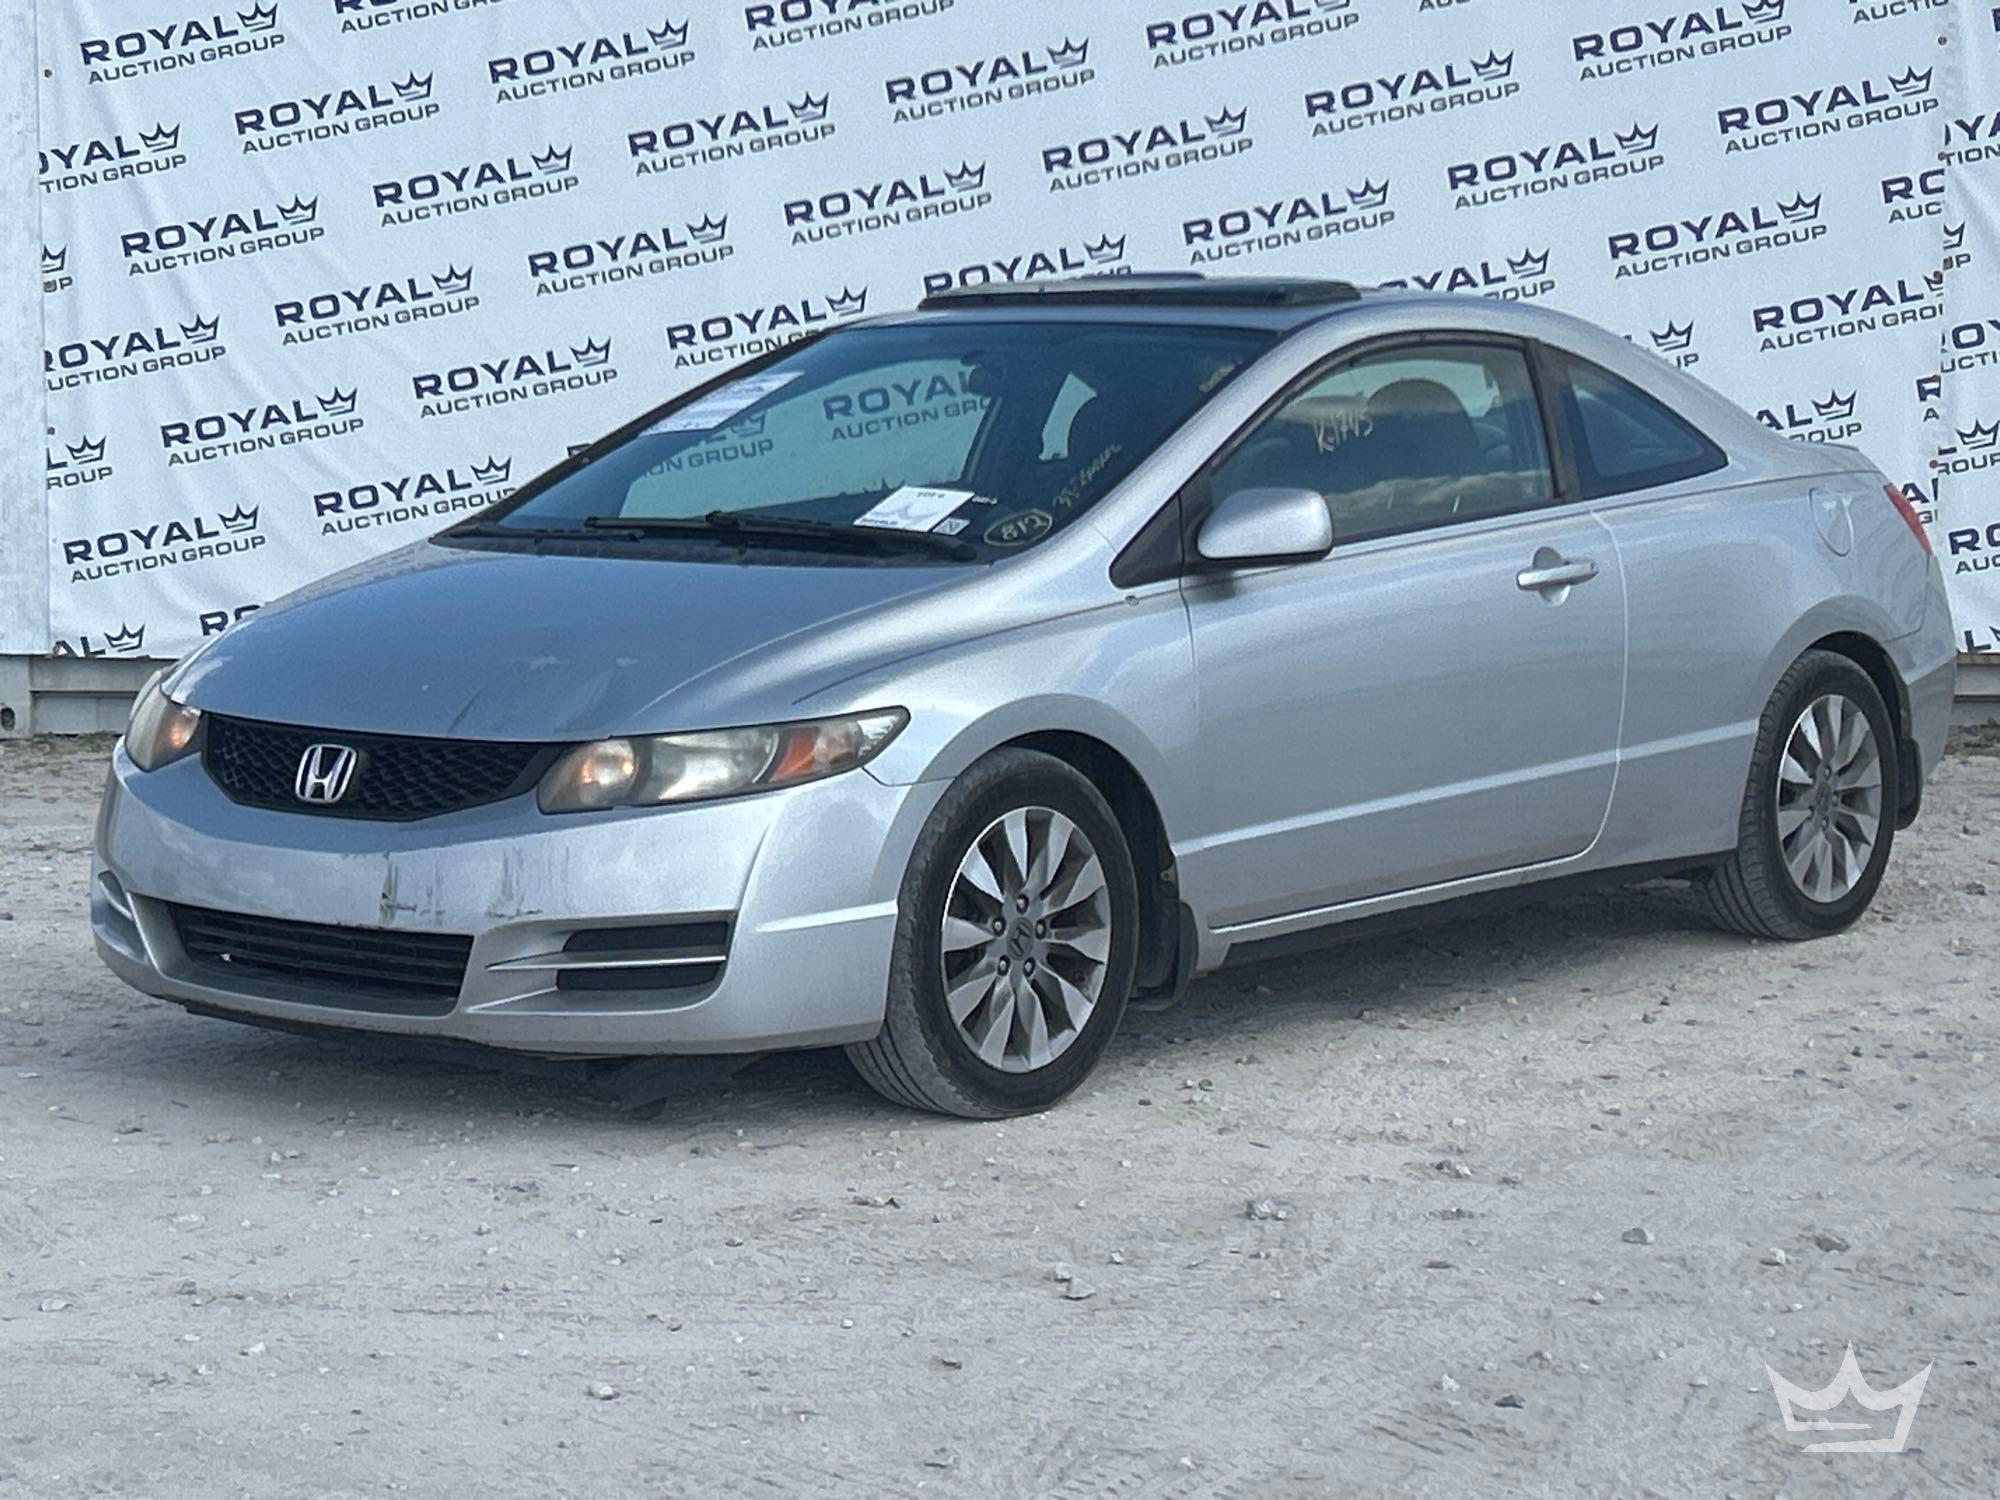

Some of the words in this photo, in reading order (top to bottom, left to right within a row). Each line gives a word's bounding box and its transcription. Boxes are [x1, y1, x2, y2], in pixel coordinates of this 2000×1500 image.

[80, 16, 239, 66] ROYAL
[342, 0, 450, 34] AUCTION
[753, 15, 862, 51] AUCTION
[867, 0, 955, 26] GROUP
[1146, 0, 1311, 50] ROYAL
[1154, 32, 1265, 69] AUCTION
[1270, 13, 1359, 44] GROUP
[1573, 7, 1743, 62] ROYAL
[88, 52, 195, 85] AUCTION
[200, 34, 285, 62] GROUP
[488, 32, 649, 84] ROYAL
[497, 69, 604, 104] AUCTION
[610, 51, 695, 80] GROUP
[885, 51, 1048, 104] ROYAL
[1580, 45, 1695, 81] AUCTION
[1700, 25, 1791, 55] GROUP
[235, 85, 394, 135] ROYAL
[894, 88, 1002, 123] AUCTION
[1008, 69, 1094, 100] GROUP
[1305, 63, 1471, 118] ROYAL
[1312, 101, 1424, 137] AUCTION
[1430, 82, 1520, 112] GROUP
[1718, 80, 1889, 135] ROYAL
[243, 120, 350, 154] AUCTION
[355, 103, 440, 131] GROUP
[628, 105, 789, 157] ROYAL
[636, 142, 744, 177] AUCTION
[749, 123, 835, 153] GROUP
[1042, 120, 1206, 174] ROYAL
[1725, 118, 1841, 155] AUCTION
[1847, 98, 1939, 128] GROUP
[102, 154, 186, 181] GROUP
[373, 157, 532, 208] ROYAL
[1050, 157, 1160, 193] AUCTION
[1165, 138, 1253, 168] GROUP
[1447, 137, 1616, 190] ROYAL
[1455, 174, 1568, 210] AUCTION
[1574, 155, 1664, 185] GROUP
[381, 194, 489, 227] AUCTION
[494, 176, 579, 204] GROUP
[784, 175, 945, 227] ROYAL
[792, 211, 900, 246] AUCTION
[906, 192, 992, 222] GROUP
[1183, 192, 1348, 246] ROYAL
[121, 208, 279, 258] ROYAL
[129, 244, 235, 276] AUCTION
[240, 227, 324, 255] GROUP
[528, 228, 688, 278] ROYAL
[1190, 229, 1301, 265] AUCTION
[1307, 210, 1395, 240] GROUP
[1608, 206, 1778, 260] ROYAL
[1615, 244, 1730, 279] AUCTION
[1736, 225, 1827, 254] GROUP
[537, 263, 643, 296] AUCTION
[649, 245, 734, 274] GROUP
[274, 278, 433, 327] ROYAL
[283, 313, 390, 346] AUCTION
[394, 296, 479, 324] GROUP
[666, 299, 827, 350] ROYAL
[1753, 279, 1924, 333] ROYAL
[1760, 317, 1876, 352] AUCTION
[1882, 303, 1943, 327] GRO
[44, 327, 181, 372] OYAL
[143, 346, 226, 373] GROUP
[412, 350, 572, 400] ROYAL
[675, 336, 783, 369] AUCTION
[421, 386, 528, 418] AUCTION
[533, 369, 617, 396] GROUP
[160, 400, 318, 448] ROYAL
[168, 435, 275, 467] AUCTION
[280, 418, 363, 445] GROUP
[832, 408, 939, 441] AUCTION
[688, 438, 774, 468] GROUP
[314, 469, 472, 517] ROYAL
[63, 517, 220, 565] ROYAL
[322, 504, 429, 536] AUCTION
[71, 552, 177, 583] AUCTION
[182, 536, 266, 562] GROUP
